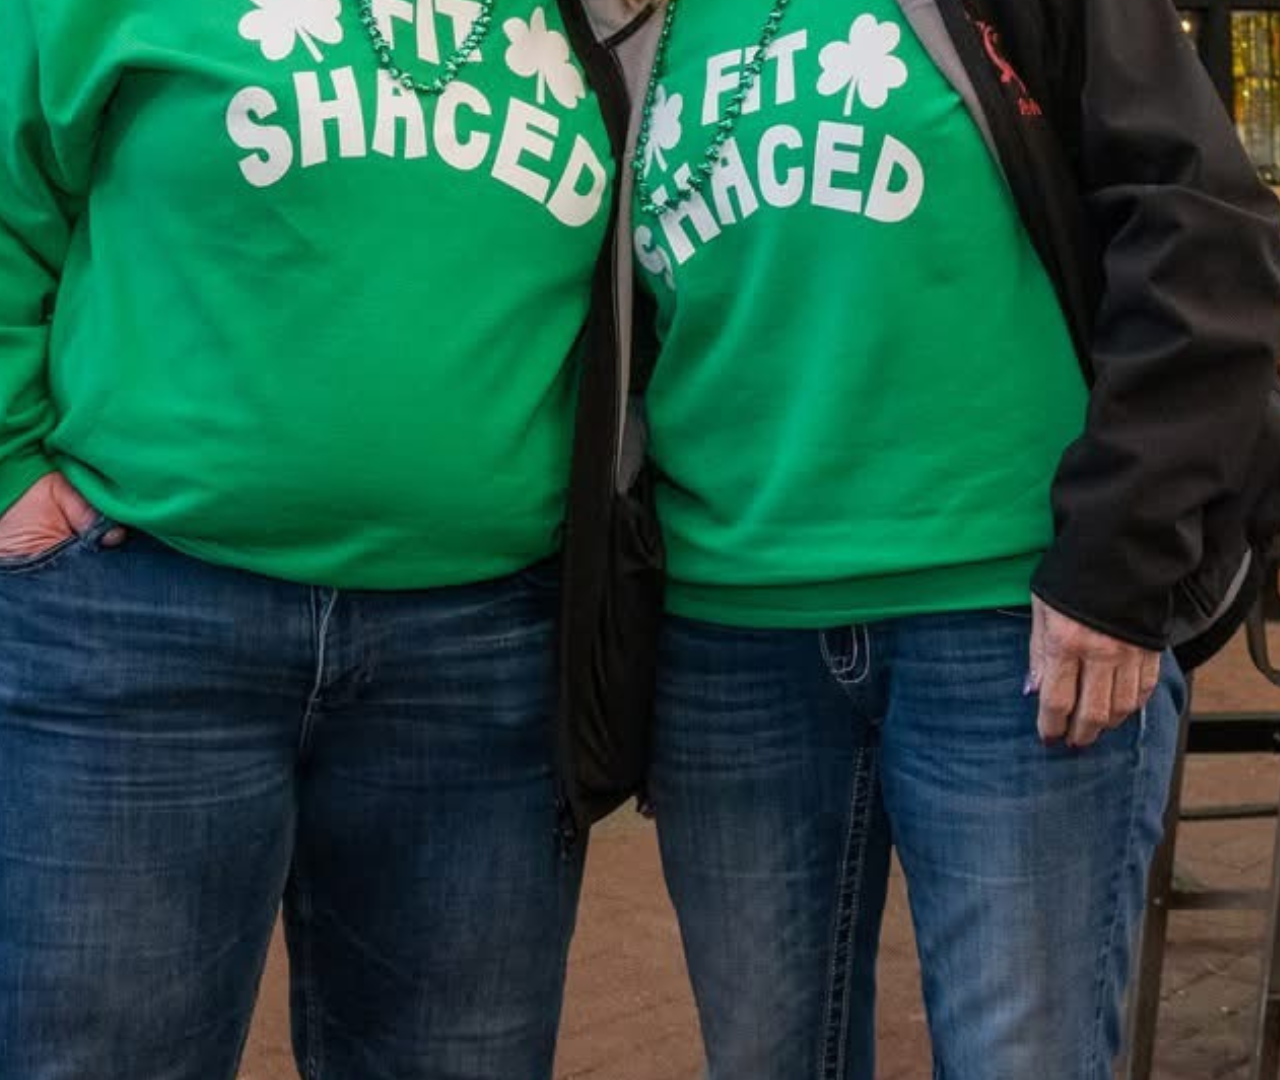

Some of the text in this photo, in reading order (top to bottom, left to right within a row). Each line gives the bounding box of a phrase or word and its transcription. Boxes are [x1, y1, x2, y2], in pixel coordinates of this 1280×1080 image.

[225, 65, 607, 227] SHACED
[700, 28, 808, 126] FIT
[633, 119, 925, 291] SHACED
